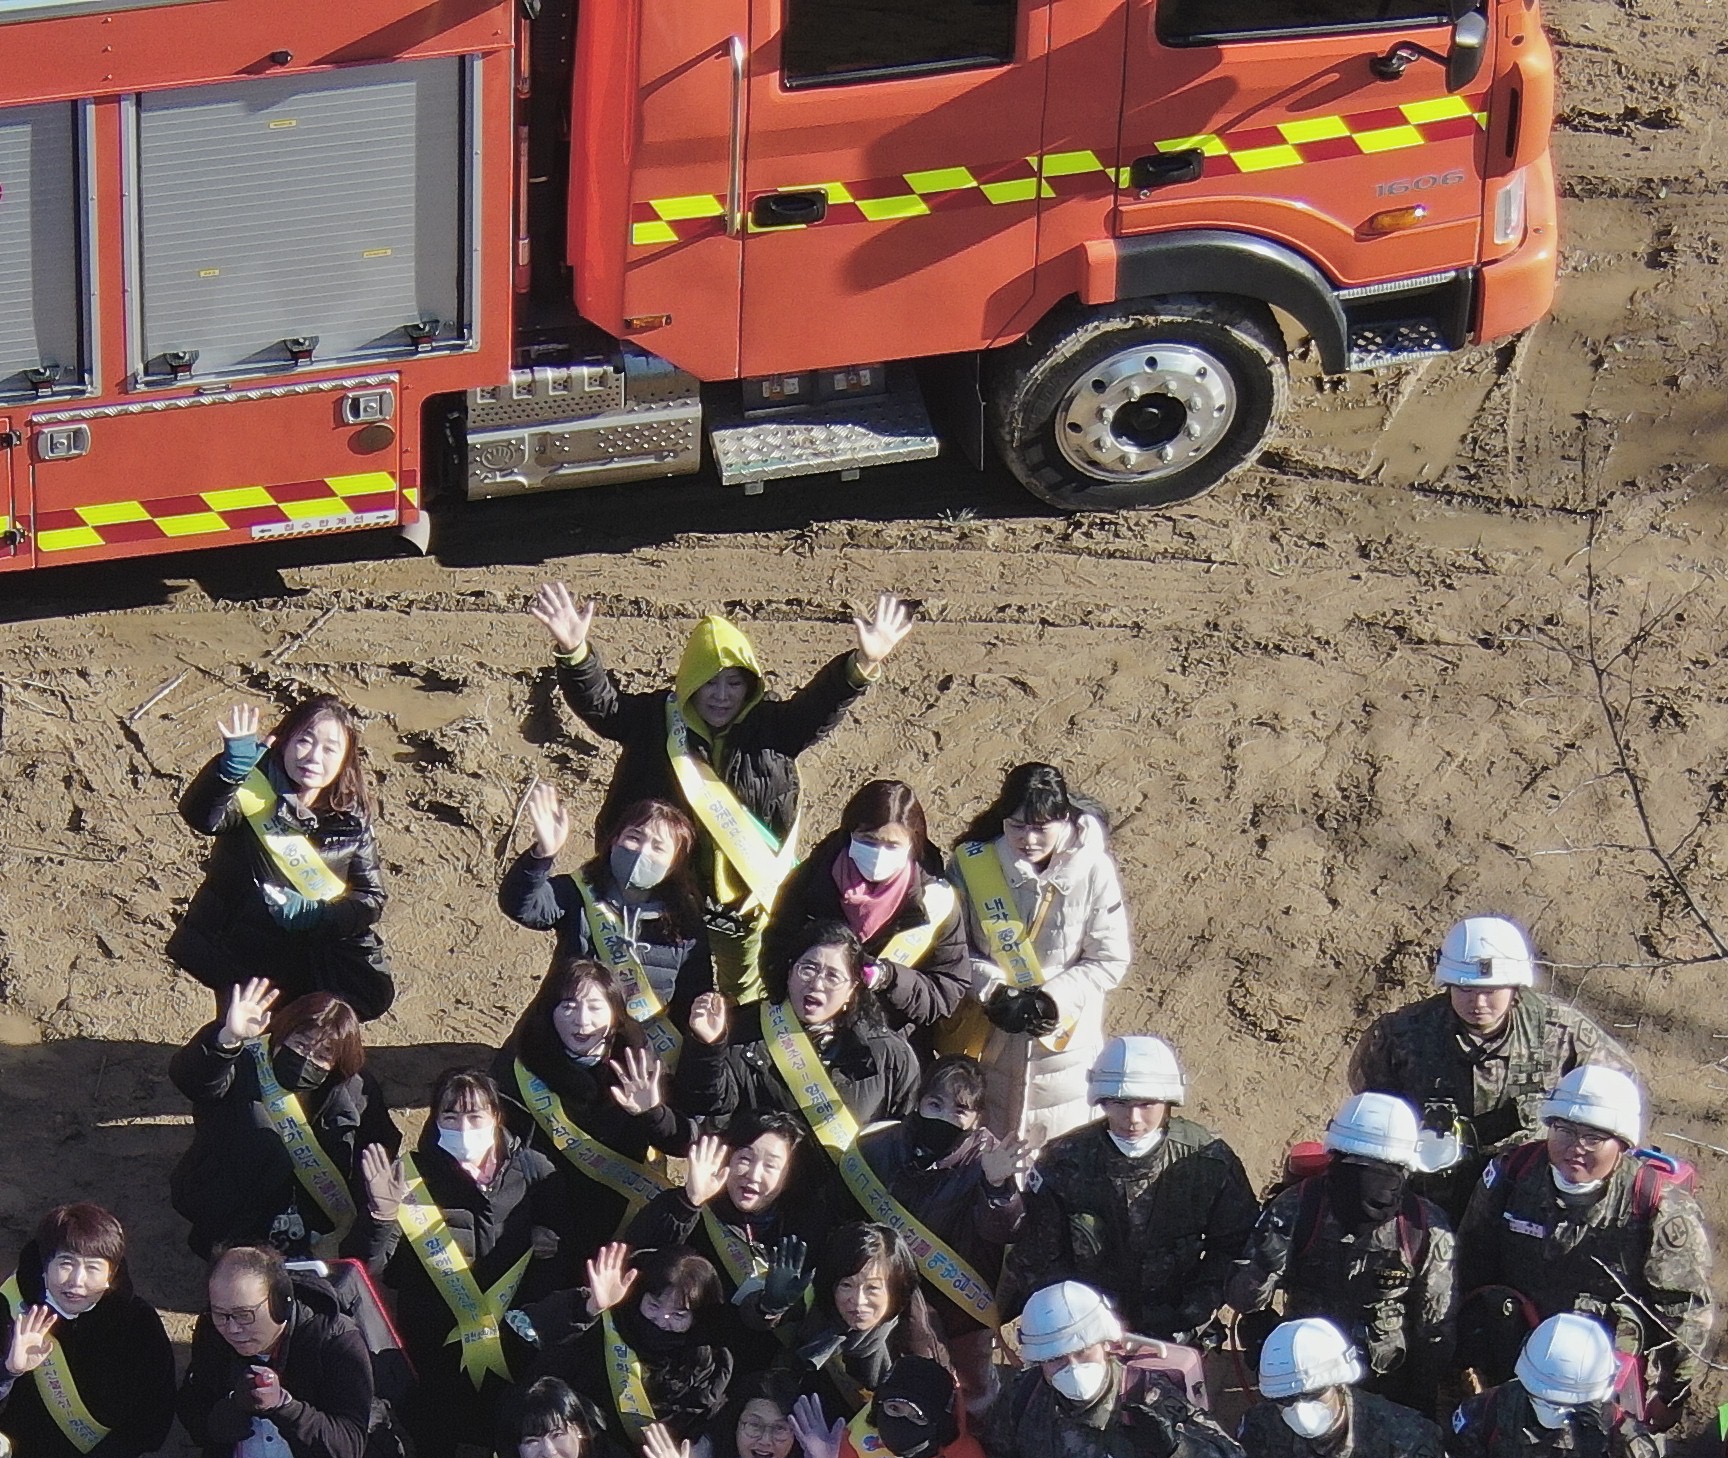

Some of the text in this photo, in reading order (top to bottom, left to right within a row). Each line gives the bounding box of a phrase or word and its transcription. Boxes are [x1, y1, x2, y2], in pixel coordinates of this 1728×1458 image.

[1375, 169, 1464, 198] 1606
[984, 897, 1010, 925] 내가
[997, 927, 1021, 953] 좋아
[534, 1095, 553, 1112] 그
[277, 1115, 305, 1144] 내가
[292, 1146, 320, 1170] 먼저
[854, 1173, 870, 1191] 그
